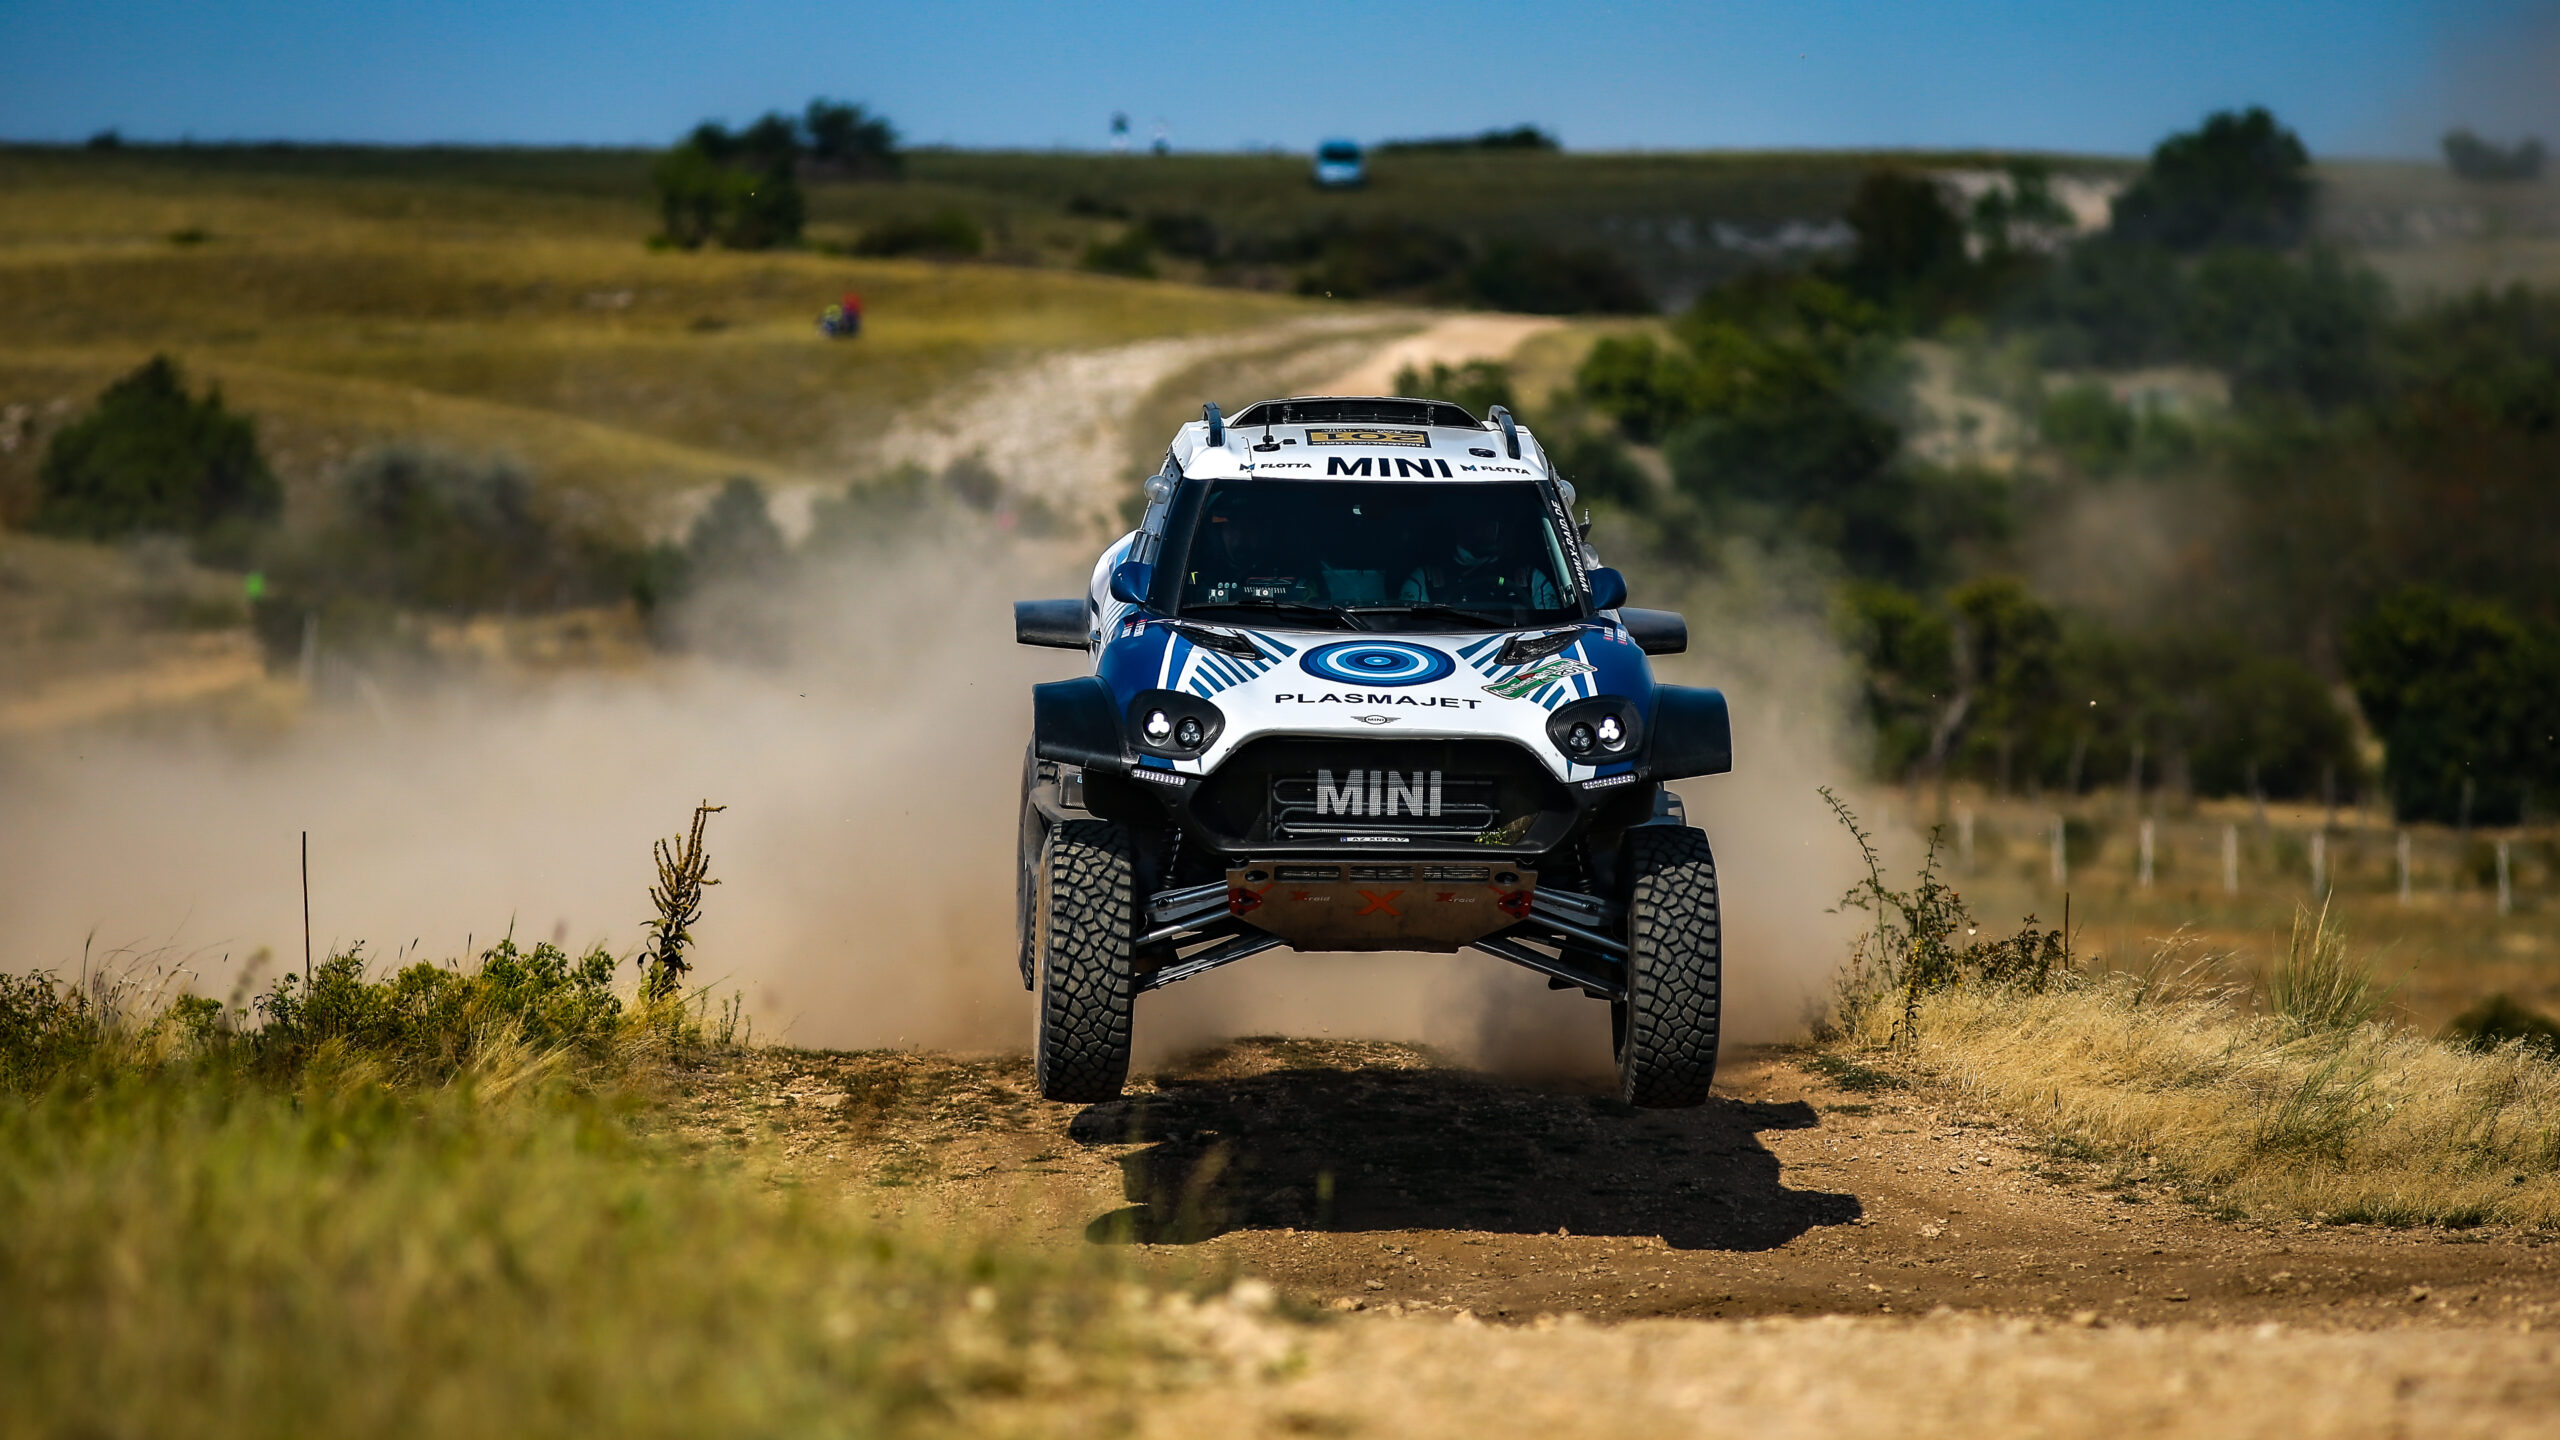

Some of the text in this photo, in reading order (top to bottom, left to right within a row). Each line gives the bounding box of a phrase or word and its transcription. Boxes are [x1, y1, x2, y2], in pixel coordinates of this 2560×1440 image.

[1321, 432, 1421, 442] 201
[1327, 456, 1453, 478] MINI
[1480, 465, 1531, 475] FLOTTA
[1551, 499, 1590, 593] WWW.X-RAID.DE
[1275, 693, 1482, 709] PLASMAJET
[1317, 769, 1442, 816] MINI
